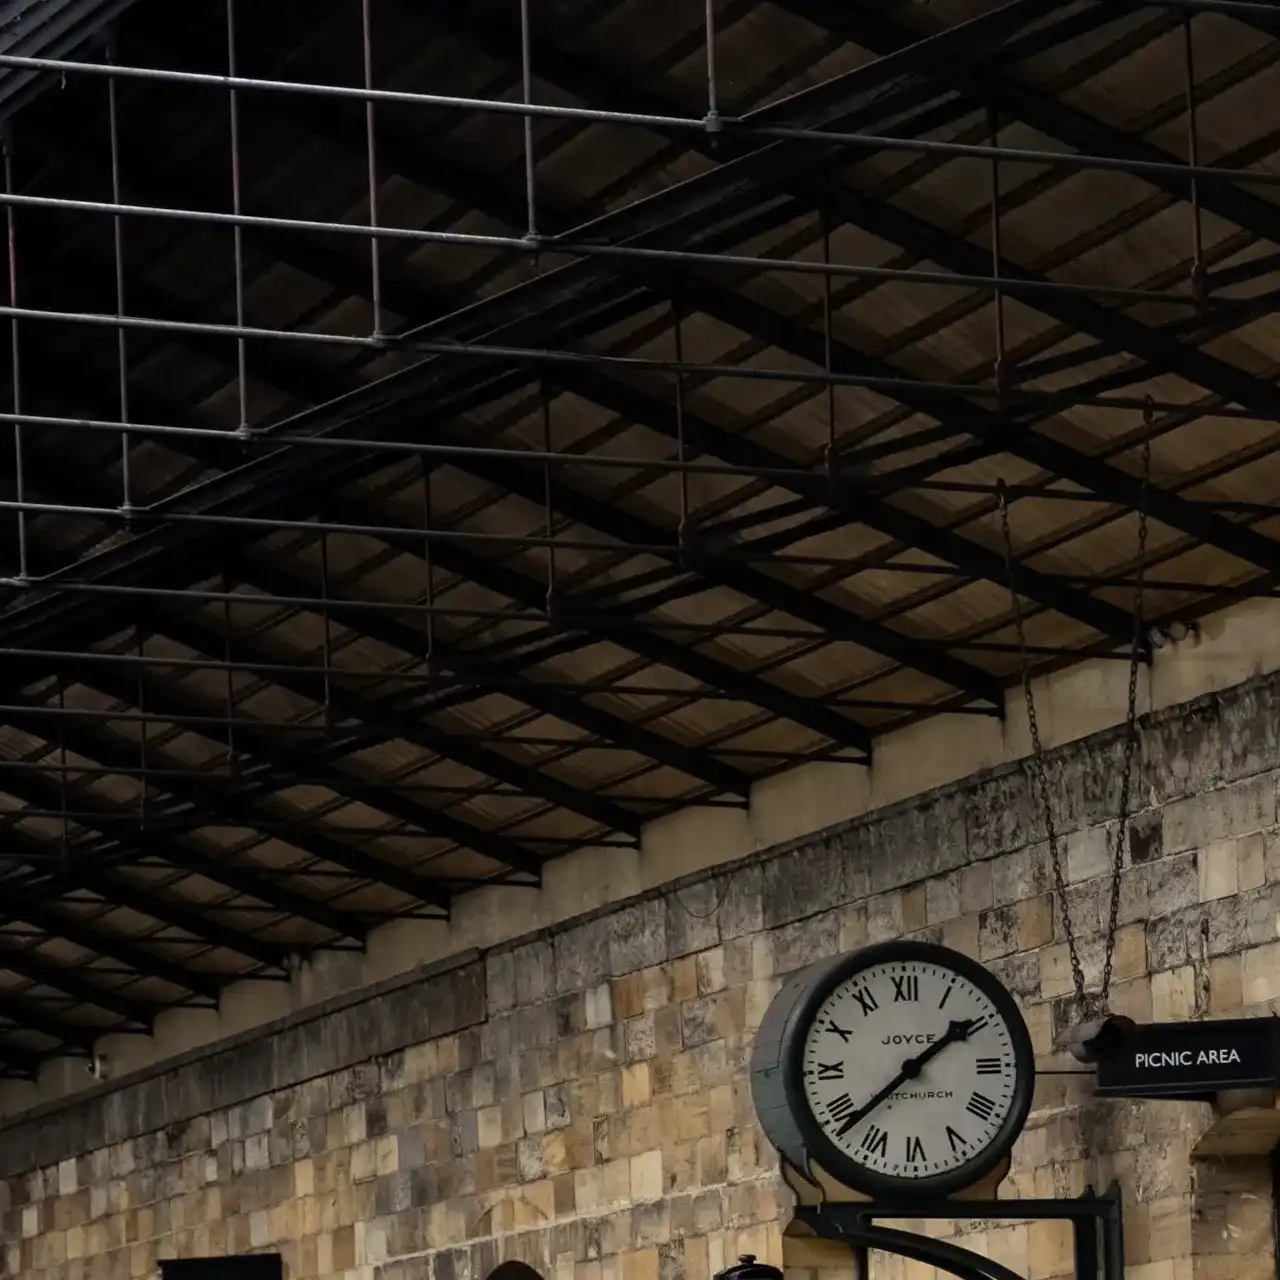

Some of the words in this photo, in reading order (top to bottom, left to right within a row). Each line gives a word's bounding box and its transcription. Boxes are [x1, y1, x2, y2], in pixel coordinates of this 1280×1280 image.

[890, 975, 919, 1002] XII
[852, 986, 880, 1017] XI
[825, 1019, 853, 1043] X
[881, 1033, 936, 1045] JOYCE
[975, 1058, 1002, 1075] III
[1135, 1051, 1193, 1068] PICNIC
[1196, 1048, 1241, 1065] AREA
[817, 1060, 844, 1081] IX
[869, 1090, 954, 1101] ITCHURCH
[906, 1136, 927, 1163] VI
